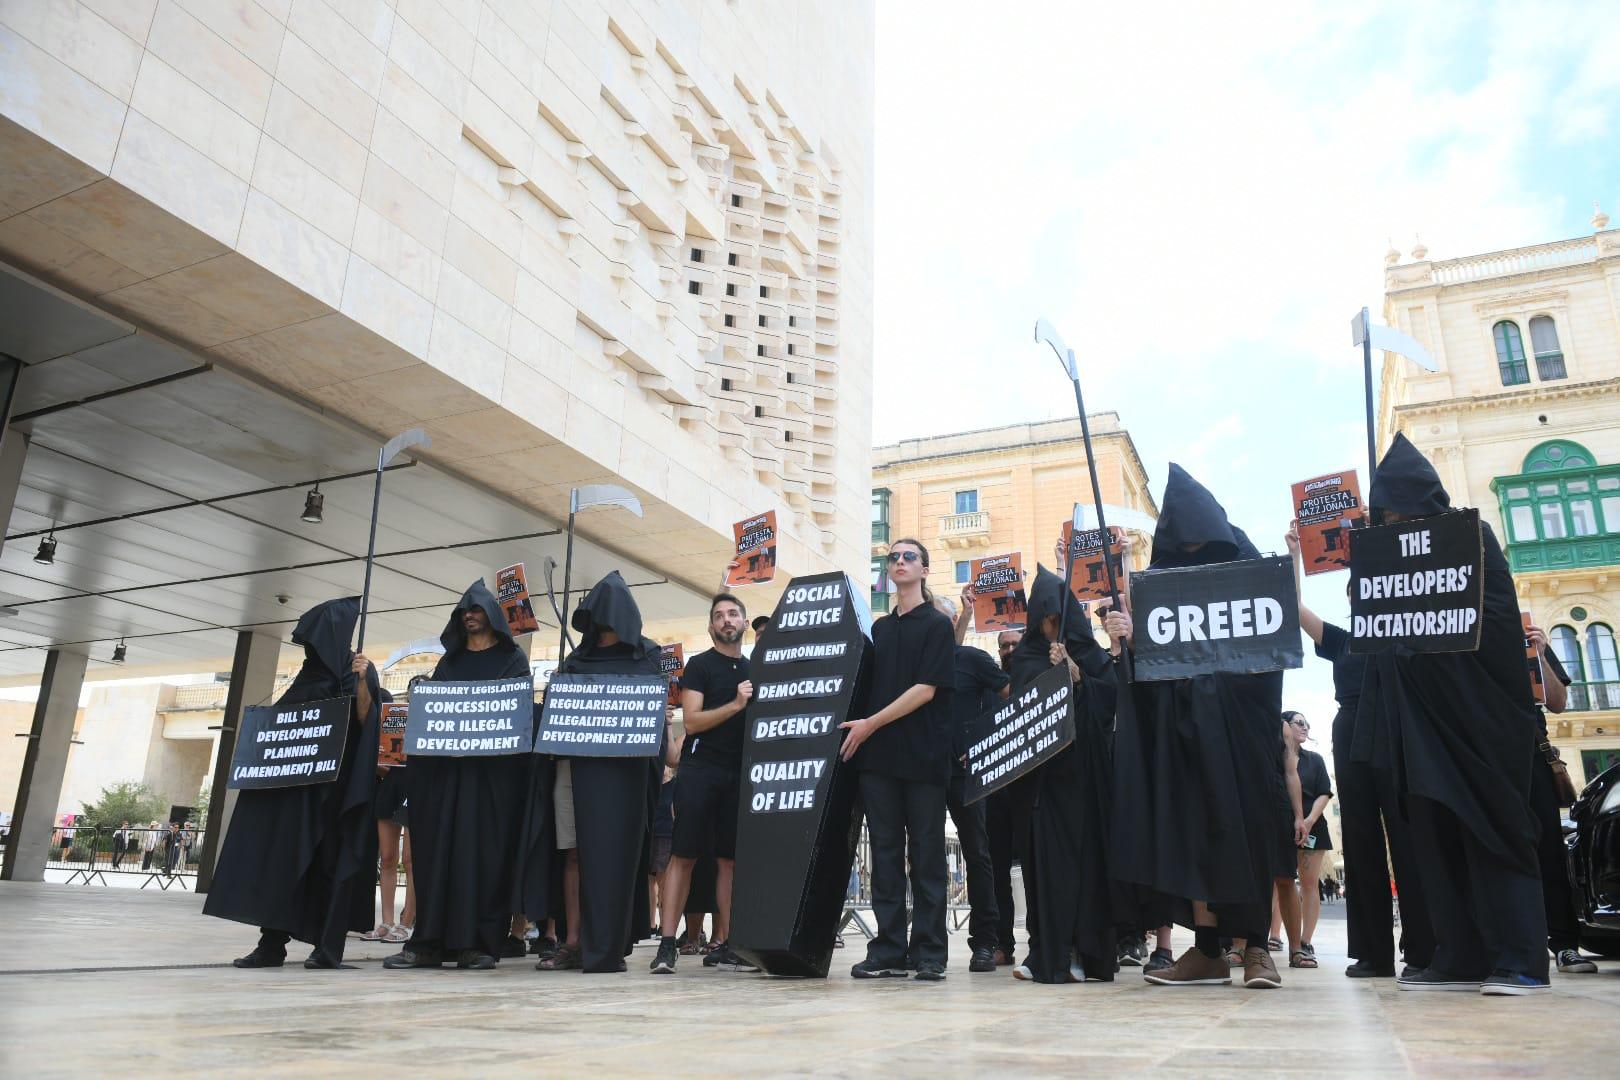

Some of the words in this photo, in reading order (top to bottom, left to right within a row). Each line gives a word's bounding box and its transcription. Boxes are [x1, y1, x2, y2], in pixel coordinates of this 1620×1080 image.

[1298, 498, 1356, 518] NAZZJONALI
[1302, 492, 1349, 508] PROTESTA
[1398, 530, 1431, 557] THE
[980, 568, 1013, 580] PROTESTA
[1360, 565, 1472, 600] DEVELOPERS'
[786, 584, 841, 604] SOCIAL
[778, 607, 841, 628] JUSTICE
[1148, 597, 1283, 645] GREED
[1354, 608, 1476, 637] DICTATORSHIP
[765, 643, 846, 661] ENVIRONMENT
[414, 685, 469, 694] SUBSIDIARY
[472, 682, 530, 694] LEGISLATION:
[550, 683, 605, 694] SUBSIDIARY
[607, 685, 666, 694] LEGISLATION:
[758, 678, 843, 699] DEMOCRACY
[425, 698, 518, 713] CONCESSIONS
[549, 698, 645, 711] REGULARISATION
[647, 700, 663, 711] OF
[994, 704, 1016, 725] BILL
[1019, 687, 1038, 708] 144
[276, 712, 298, 724] BILL
[302, 709, 320, 721] 143
[427, 720, 456, 732] FOR
[459, 718, 513, 732] ILLEGAL
[549, 715, 618, 727] ILLEGALITIES
[620, 717, 635, 727] IN
[636, 717, 656, 728] THE
[968, 702, 1043, 759] ENVIRONMENT
[1045, 687, 1068, 710] AND
[256, 724, 332, 742] DEVELOPMENT
[756, 716, 832, 738] DECENCY
[416, 736, 520, 750] DEVELOPMENT
[542, 731, 624, 744] DEVELOPMENT
[626, 734, 656, 744] ZONE
[971, 734, 1025, 775] PLANNING
[1027, 704, 1068, 740] REVIEW
[264, 744, 319, 759] PLANNING
[981, 747, 1034, 786] TRIBUNAL
[1036, 730, 1059, 753] BILL
[234, 762, 314, 781] (AMENDMENT)
[314, 760, 336, 772] BILL
[750, 760, 825, 783] QUALITY
[752, 792, 775, 811] OF
[778, 790, 815, 810] LIFE
